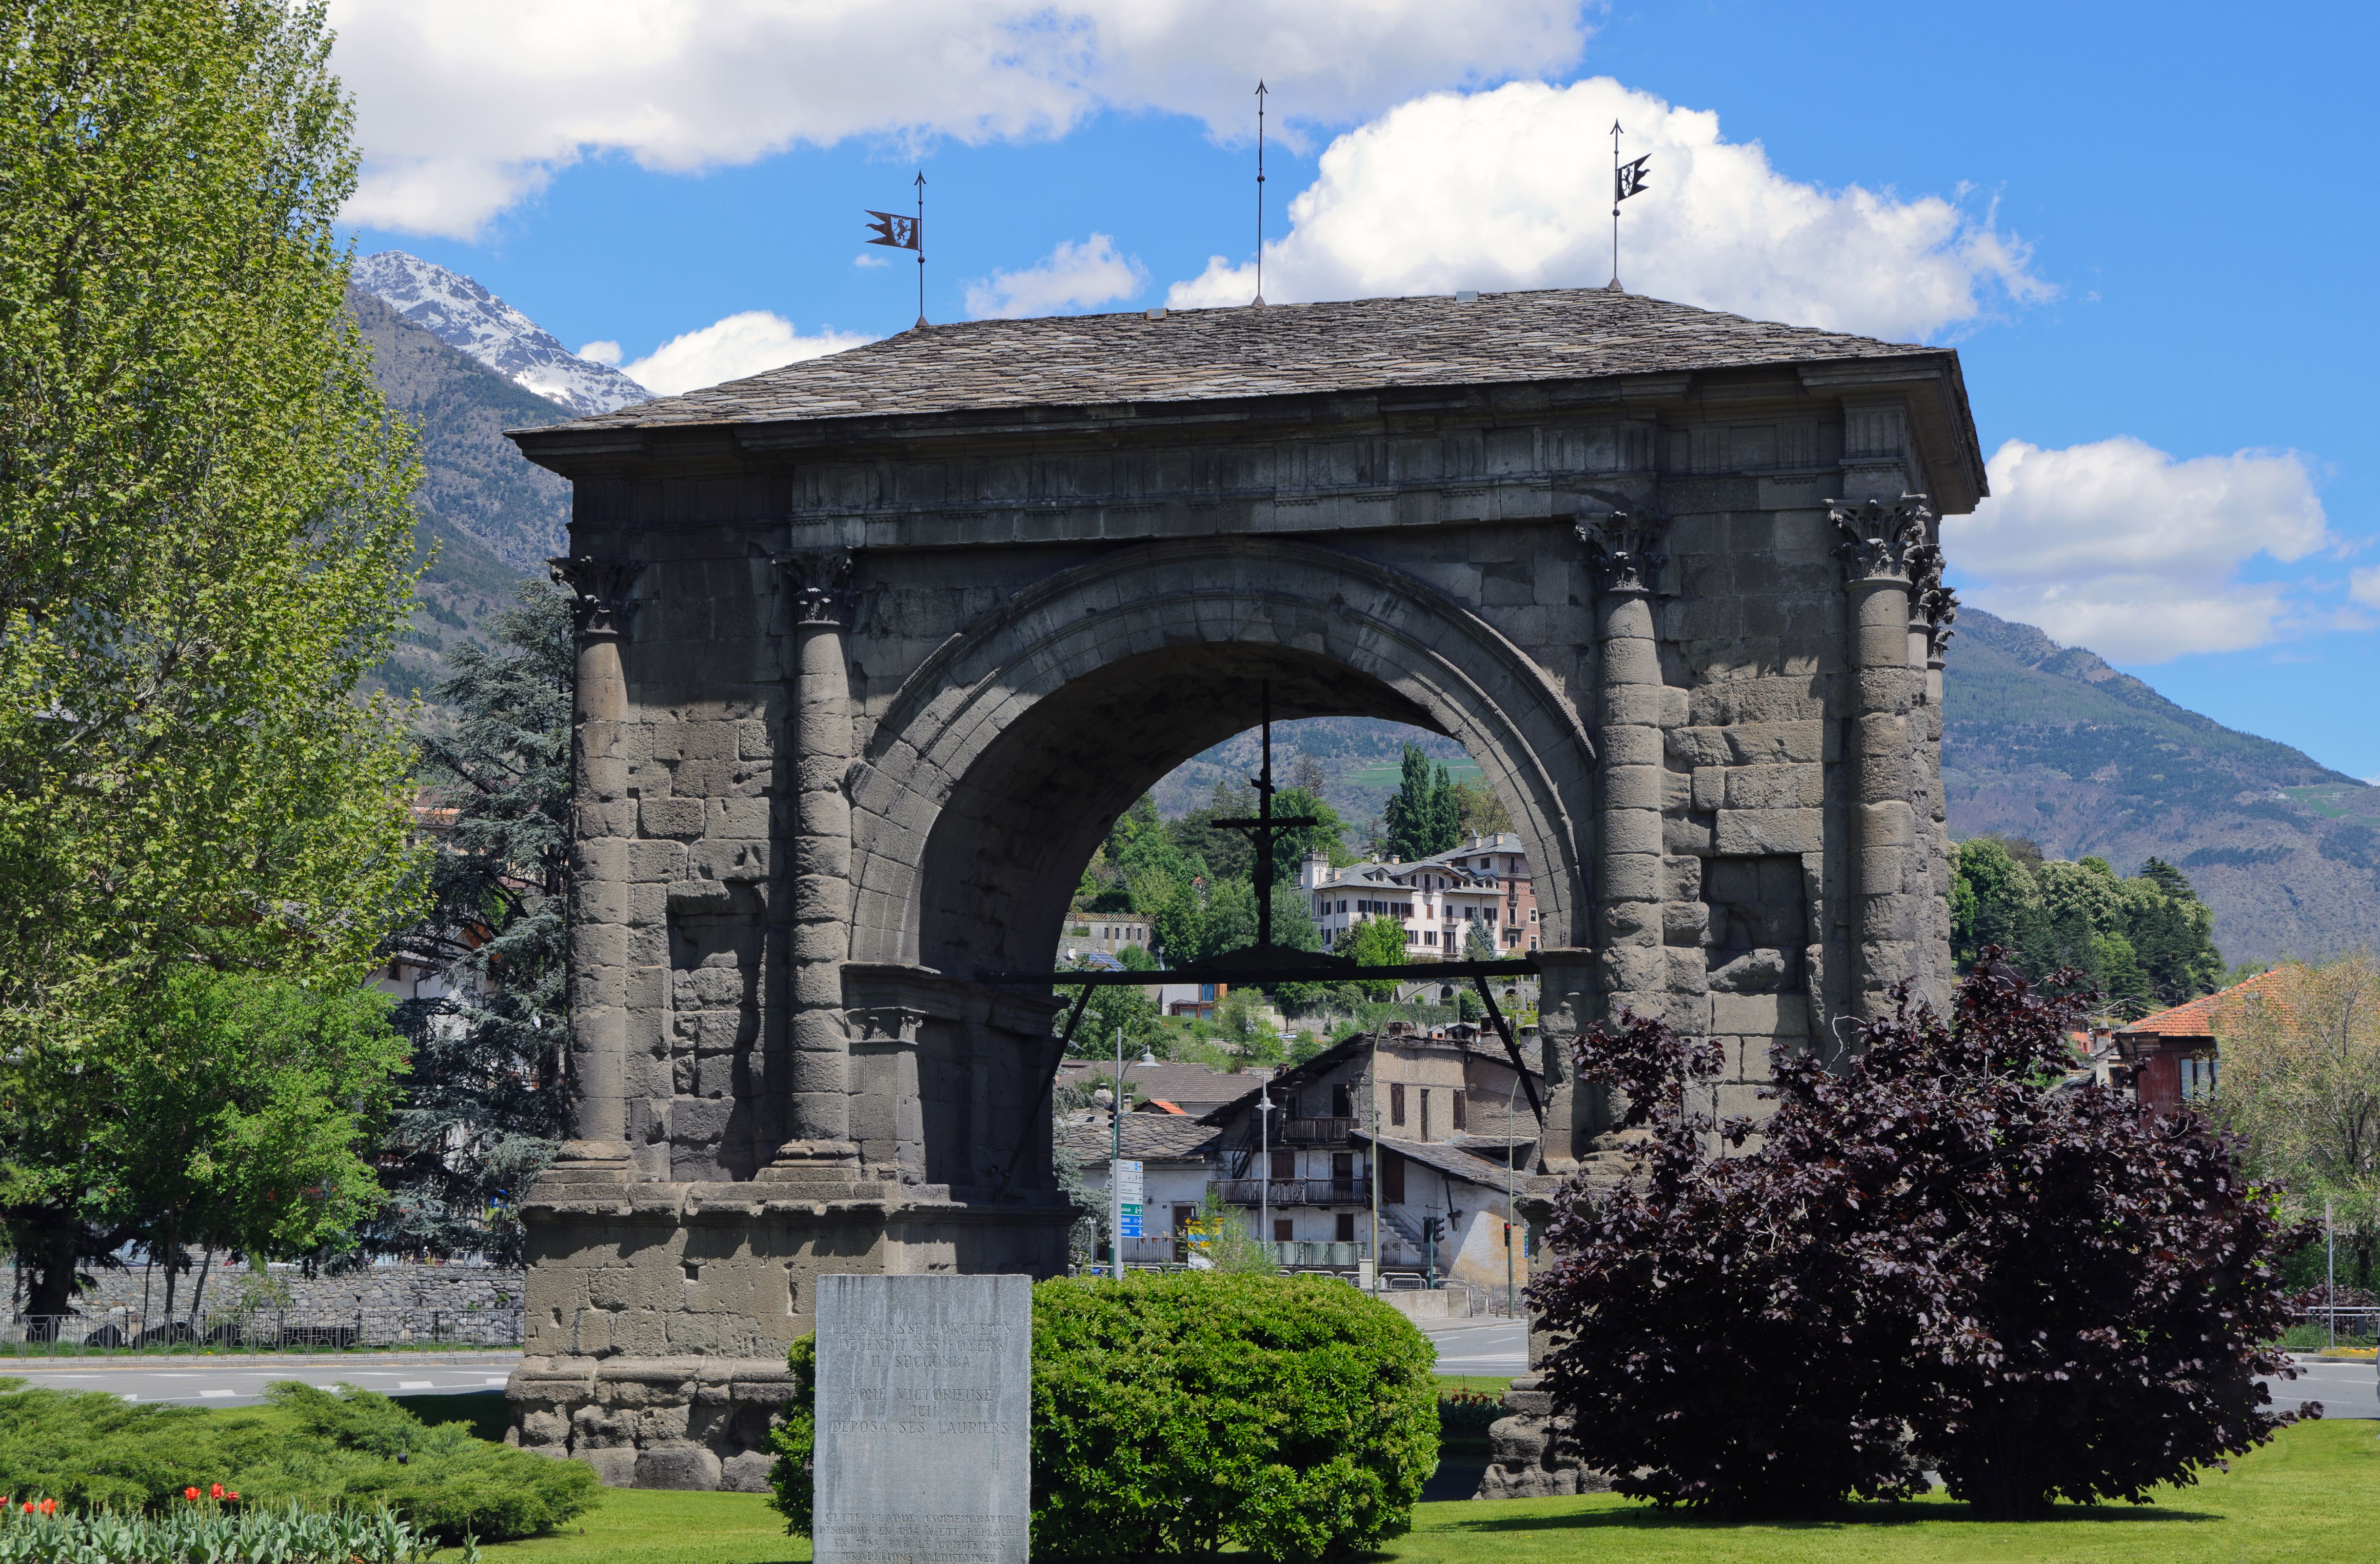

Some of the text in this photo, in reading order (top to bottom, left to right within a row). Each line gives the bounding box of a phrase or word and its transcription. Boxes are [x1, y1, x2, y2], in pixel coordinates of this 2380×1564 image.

[832, 1323, 848, 1335] LE
[860, 1323, 922, 1335] SALASSE
[916, 1340, 938, 1351] SES
[871, 1356, 883, 1367] IL
[850, 1388, 992, 1401] ROME VICTORIEUSE
[912, 1405, 930, 1417] ICI
[899, 1421, 925, 1433] SES
[826, 1513, 860, 1522] CETTE
[871, 1514, 915, 1523] PLAQUE
[818, 1526, 870, 1535] DISPARUE
[878, 1527, 891, 1535] EN
[889, 1540, 910, 1548] PAR
[984, 1541, 1006, 1550] DES
[842, 1551, 912, 1561] TRADITIONS
